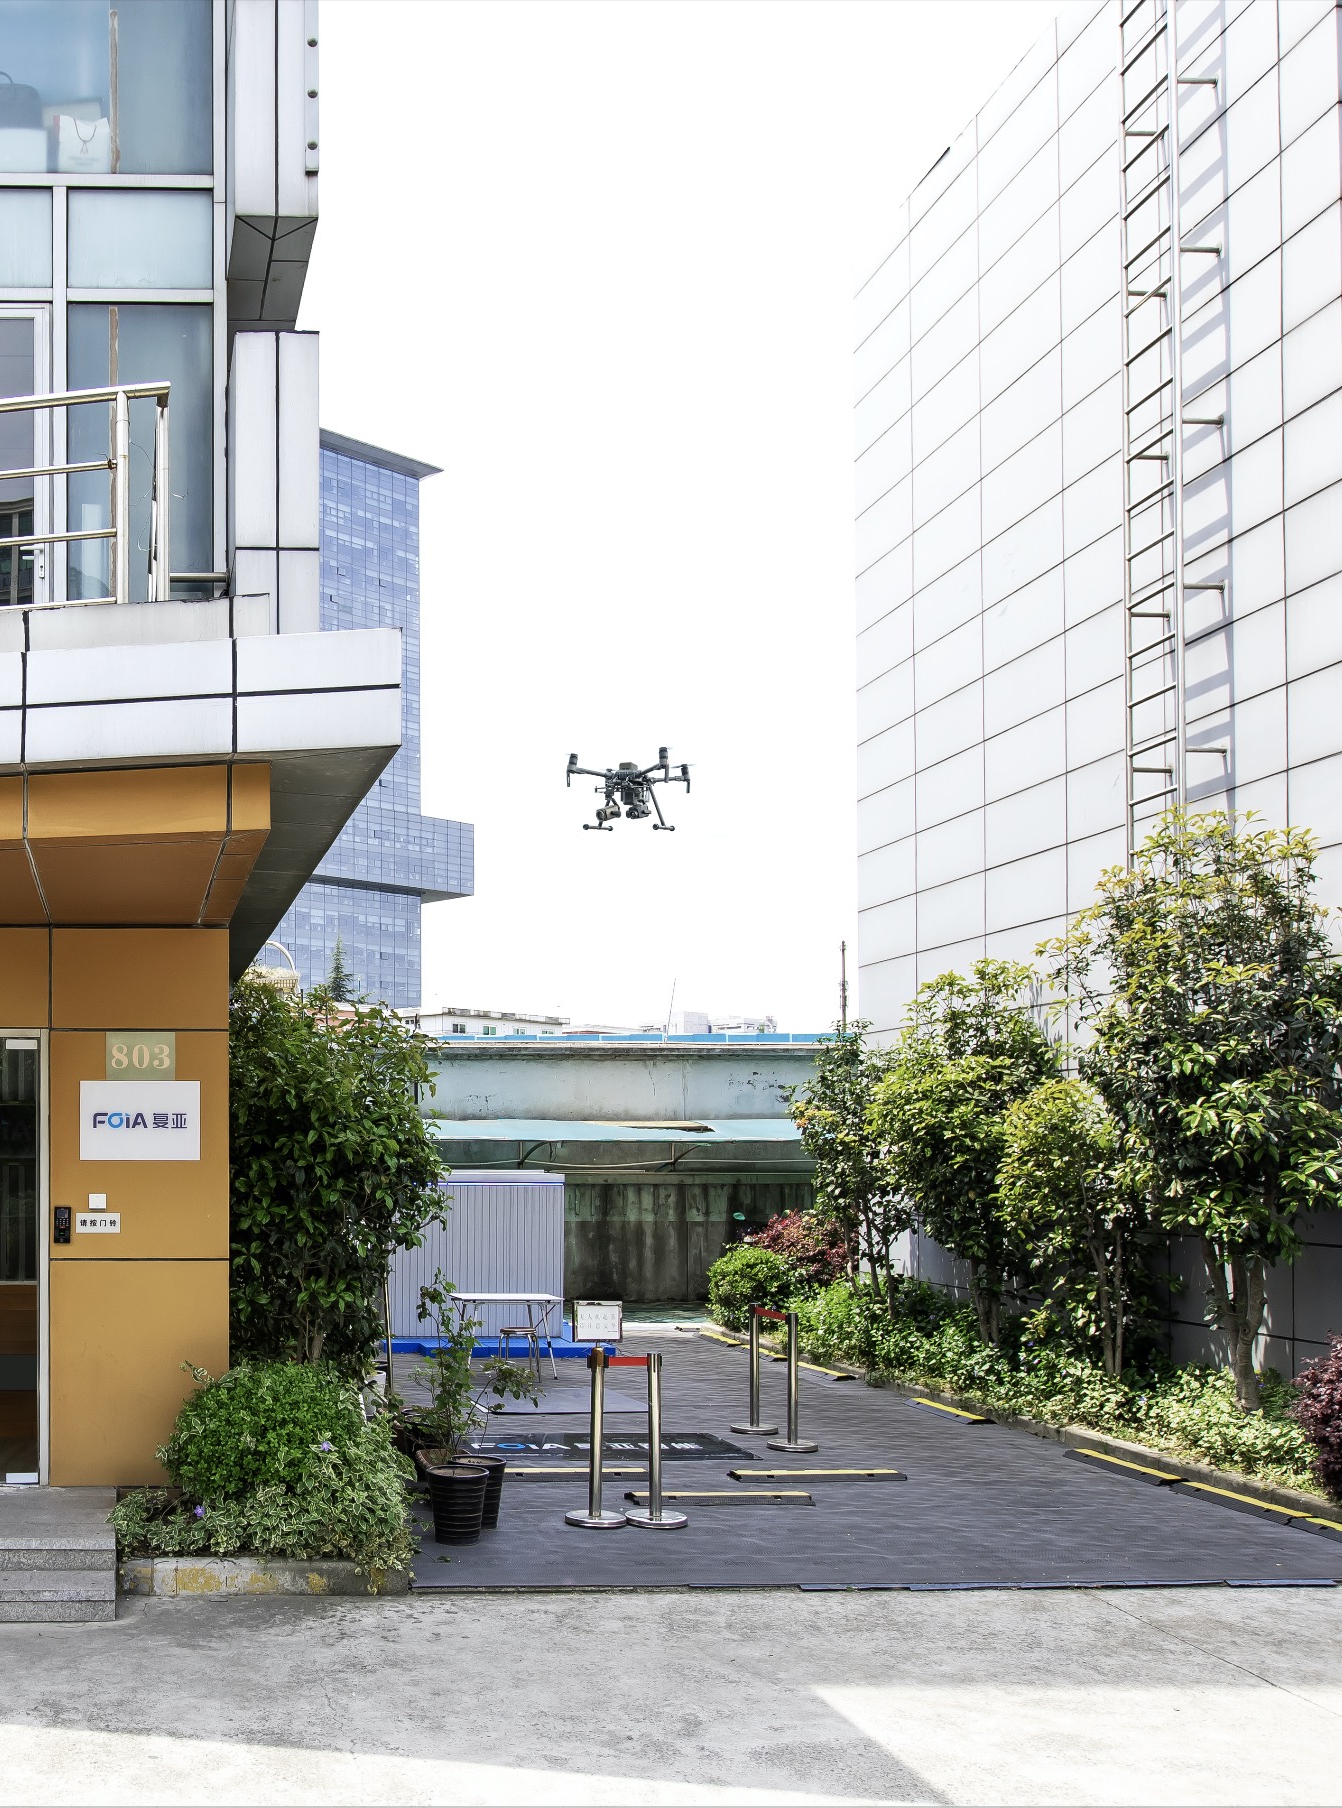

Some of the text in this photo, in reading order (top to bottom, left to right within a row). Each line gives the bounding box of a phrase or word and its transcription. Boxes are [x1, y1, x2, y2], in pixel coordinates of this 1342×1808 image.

[111, 1043, 171, 1069] 803
[152, 1112, 188, 1129] 复亚
[79, 1219, 117, 1227] 请按门铃
